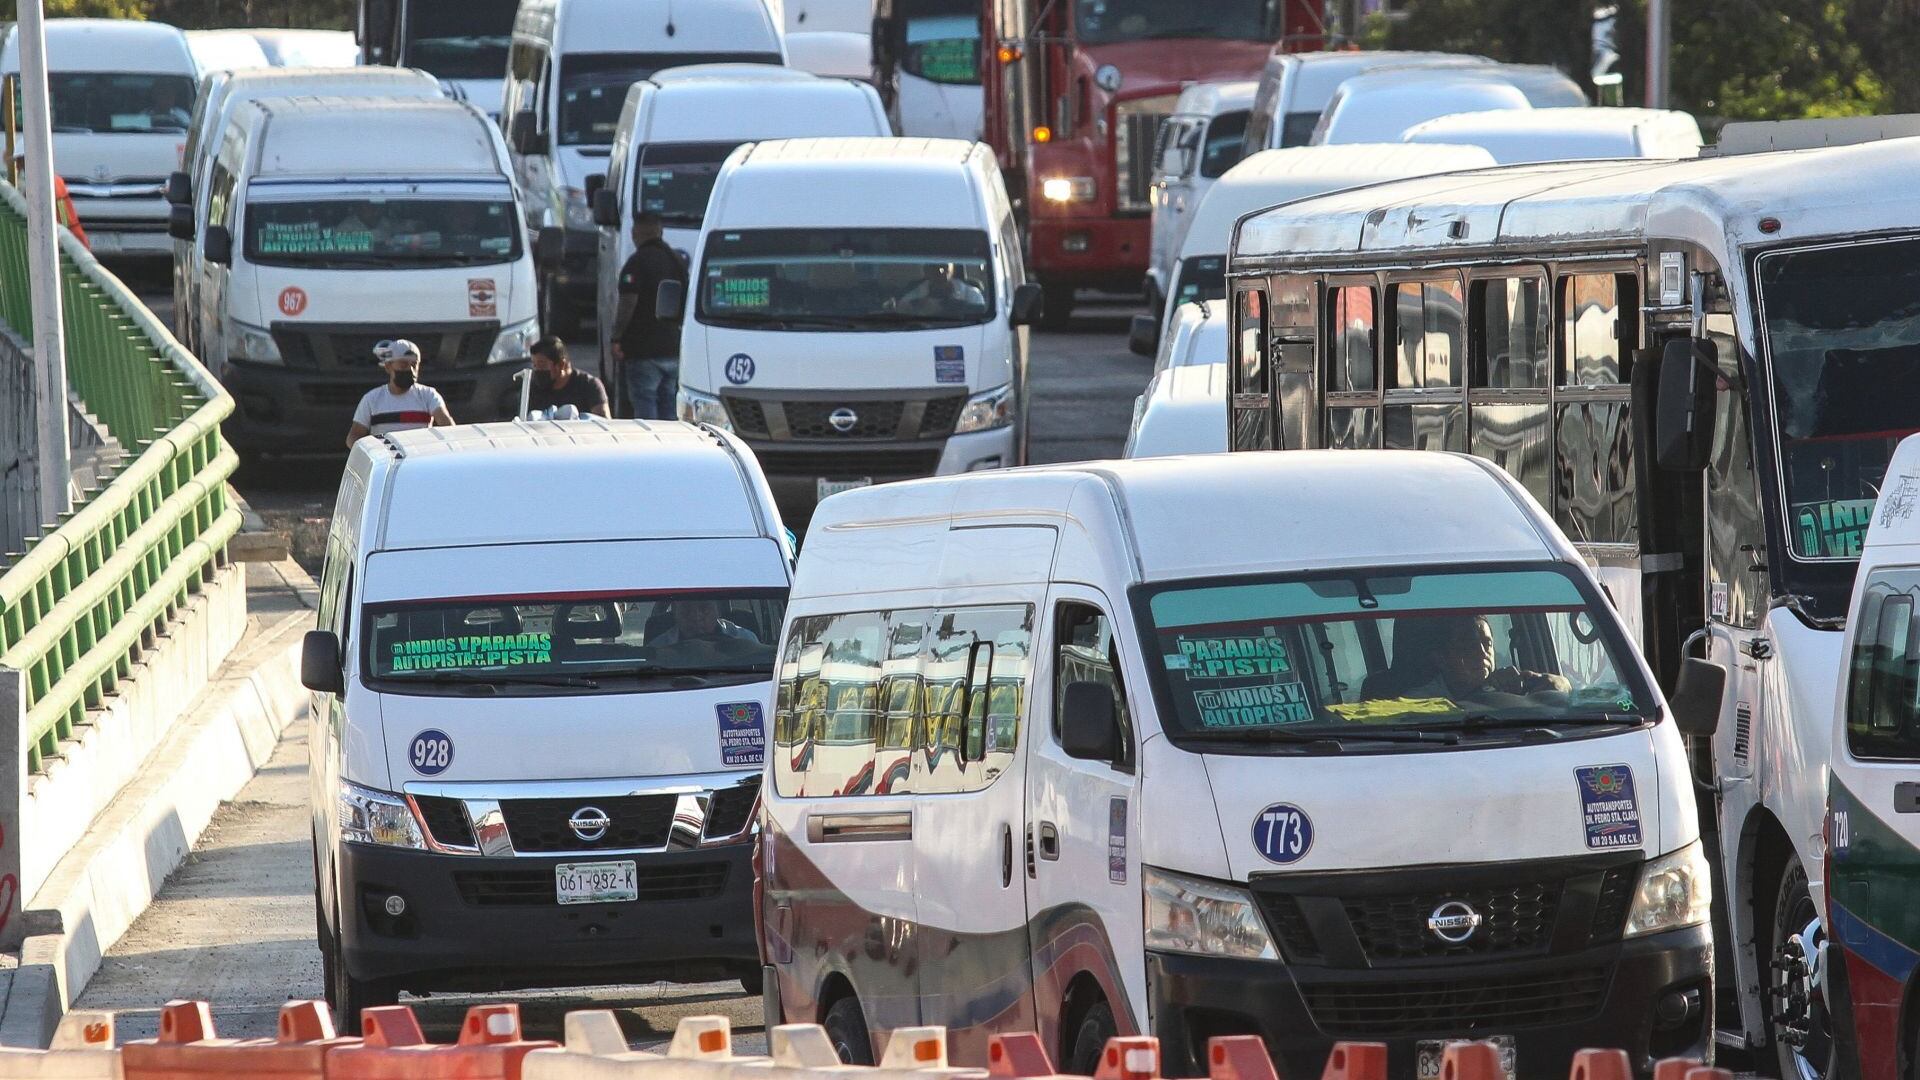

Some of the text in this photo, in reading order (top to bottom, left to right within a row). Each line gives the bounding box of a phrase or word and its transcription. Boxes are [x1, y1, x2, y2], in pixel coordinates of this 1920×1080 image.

[725, 278, 769, 291] INDIOS
[284, 292, 301, 311] 967
[729, 358, 751, 380] 452
[405, 638, 456, 654] INDIOS
[470, 633, 552, 653] PARADAS
[1180, 637, 1287, 661] PARADAS
[393, 652, 473, 671] AUTOPISTA
[487, 650, 552, 666] PISTA
[1206, 658, 1290, 677] PISTA
[1220, 685, 1286, 708] INDIOS
[1204, 702, 1311, 727] AUTOPISTA
[722, 729, 761, 738] AUTOTRANSPORTES
[415, 739, 449, 767] 928
[1587, 800, 1633, 813] AUTOTRANSPORTES
[573, 819, 606, 828] NISSAN
[1594, 812, 1611, 824] PEDRO
[1622, 810, 1638, 821] CLARA
[1263, 812, 1303, 855] 773
[1834, 811, 1848, 848] 720
[1592, 836, 1601, 846] KM
[1601, 835, 1608, 846] 20
[1619, 834, 1627, 844] DE
[1436, 916, 1475, 927] NISSAN
